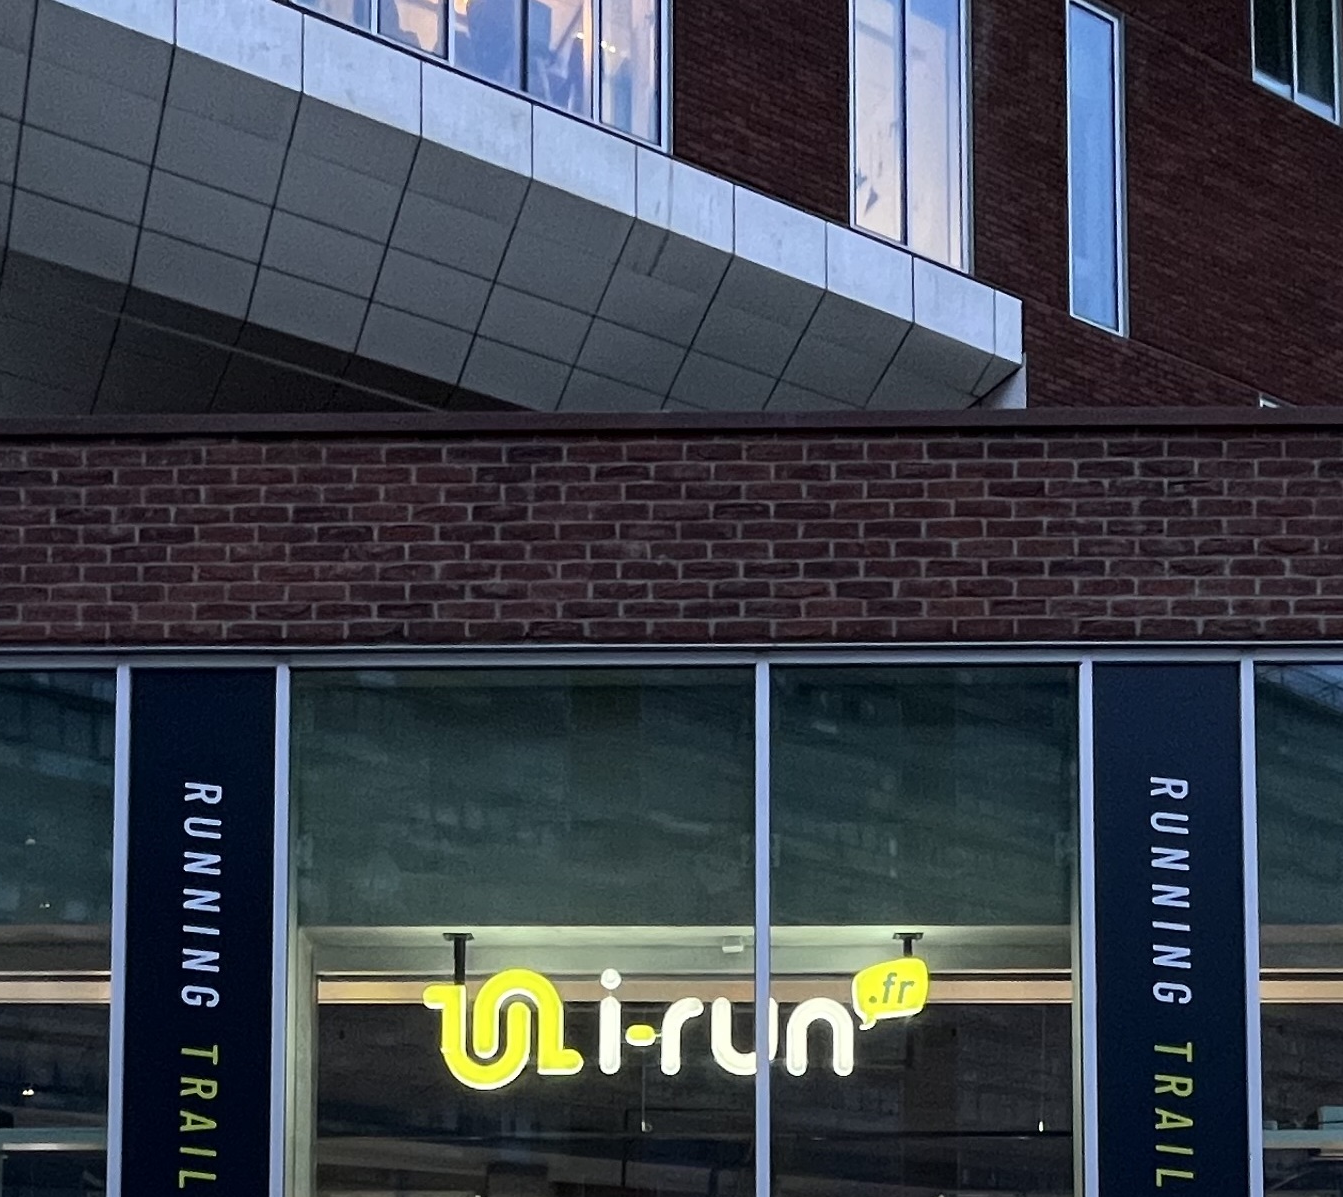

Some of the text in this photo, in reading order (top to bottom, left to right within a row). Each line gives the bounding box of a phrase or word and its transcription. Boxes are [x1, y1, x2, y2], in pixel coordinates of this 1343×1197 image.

[180, 781, 223, 1008] RUNNING
[1149, 776, 1193, 1005] RUNNING
[598, 967, 854, 1077] i-run
[178, 1044, 219, 1189] TRAIL
[1153, 1041, 1194, 1187] TRAIL
